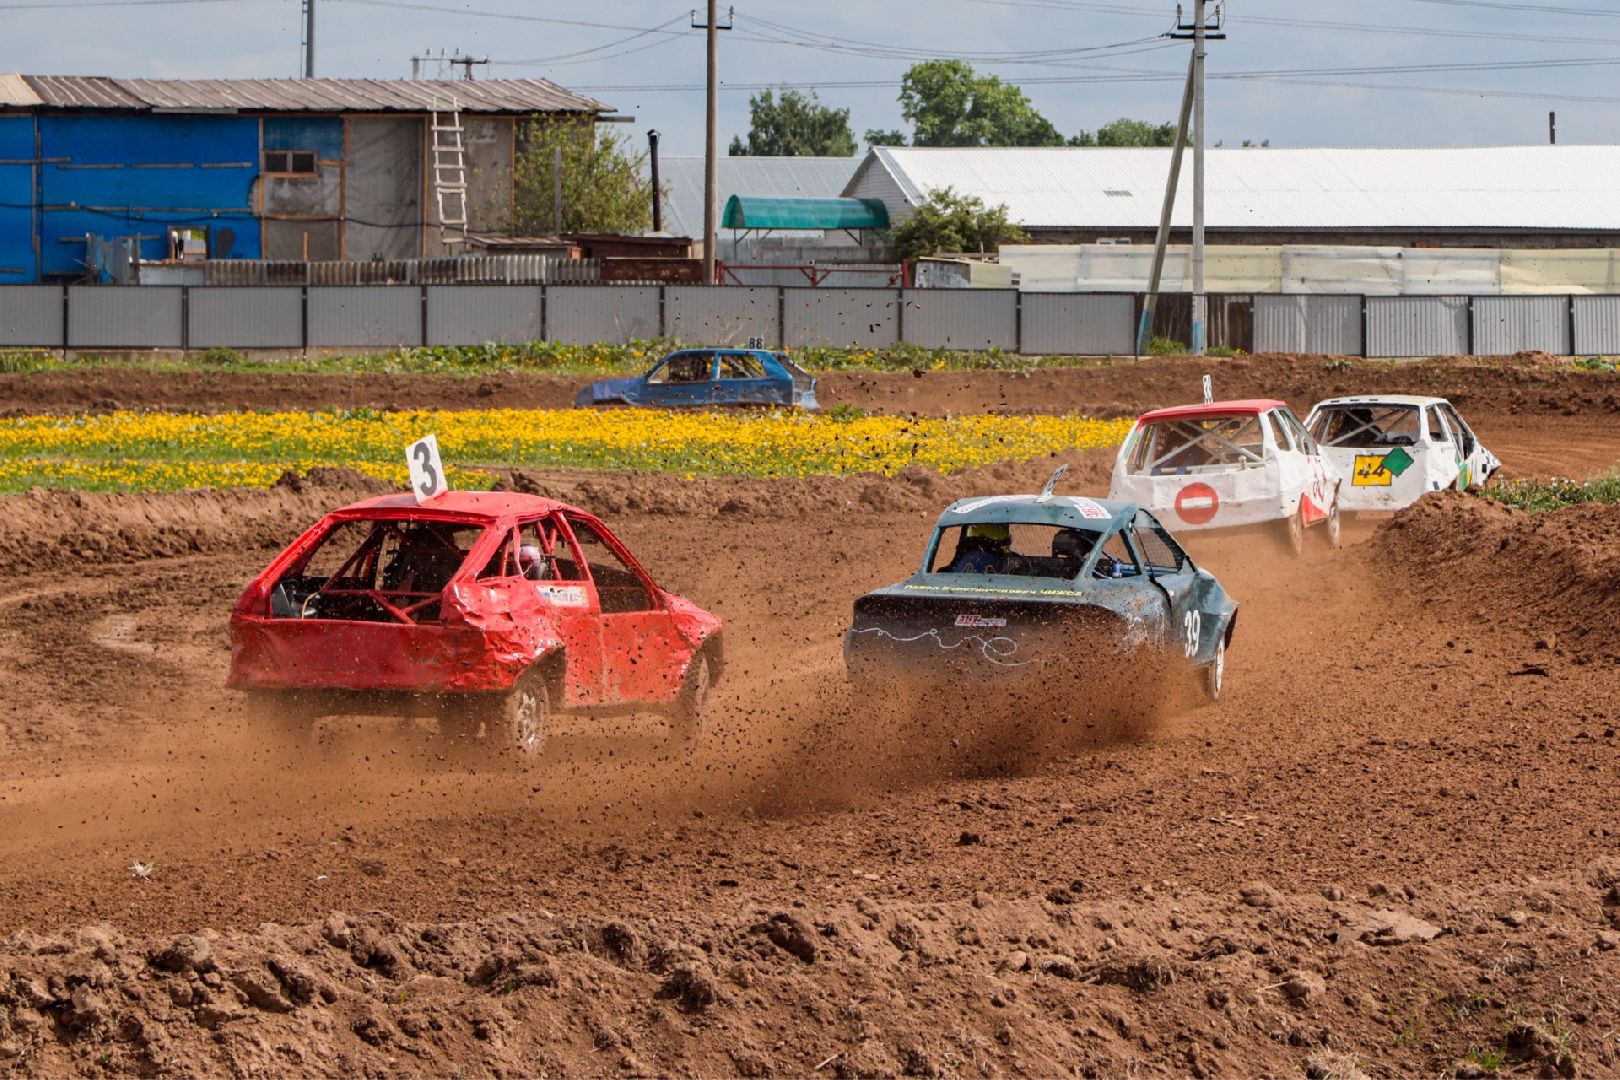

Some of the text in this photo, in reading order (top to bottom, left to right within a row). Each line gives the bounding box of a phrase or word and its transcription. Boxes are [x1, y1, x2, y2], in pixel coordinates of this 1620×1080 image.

[749, 337, 763, 349] 88
[413, 442, 438, 497] 3
[1357, 463, 1385, 478] 44
[1184, 609, 1201, 658] 39
